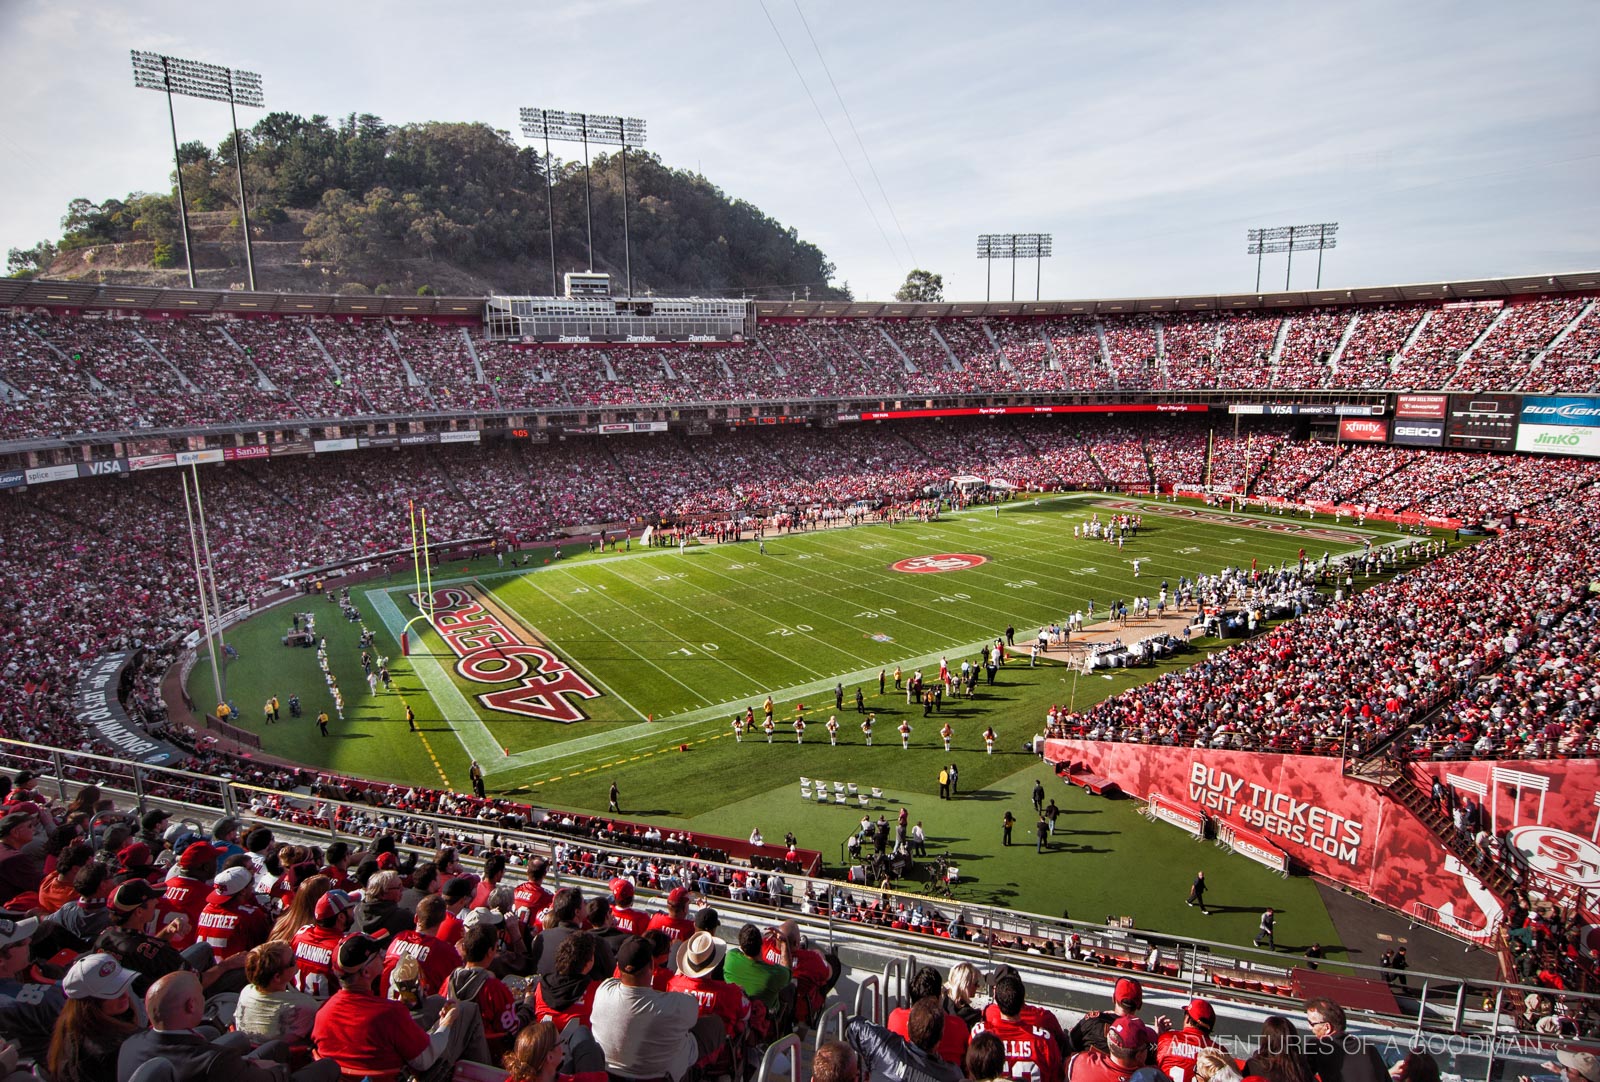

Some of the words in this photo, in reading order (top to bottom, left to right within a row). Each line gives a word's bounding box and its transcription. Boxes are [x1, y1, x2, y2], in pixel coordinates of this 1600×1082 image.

[626, 334, 656, 342] Rambus
[688, 334, 716, 342] Rambus
[1270, 405, 1293, 414] VISA
[1523, 405, 1556, 415] BUD
[1345, 421, 1380, 433] xfinity
[1394, 426, 1441, 437] GEICO
[236, 446, 268, 456] SanDisk
[89, 460, 121, 475] VISA
[28, 471, 49, 480] splice
[94, 718, 159, 755] AMAZING!
[1190, 761, 1244, 798] BUY
[1249, 782, 1364, 846] TICKETS
[1189, 782, 1237, 816] VISIT
[1238, 804, 1358, 866] 49ERS.COM
[198, 911, 238, 929] RABTREE
[296, 941, 333, 965] MANNING
